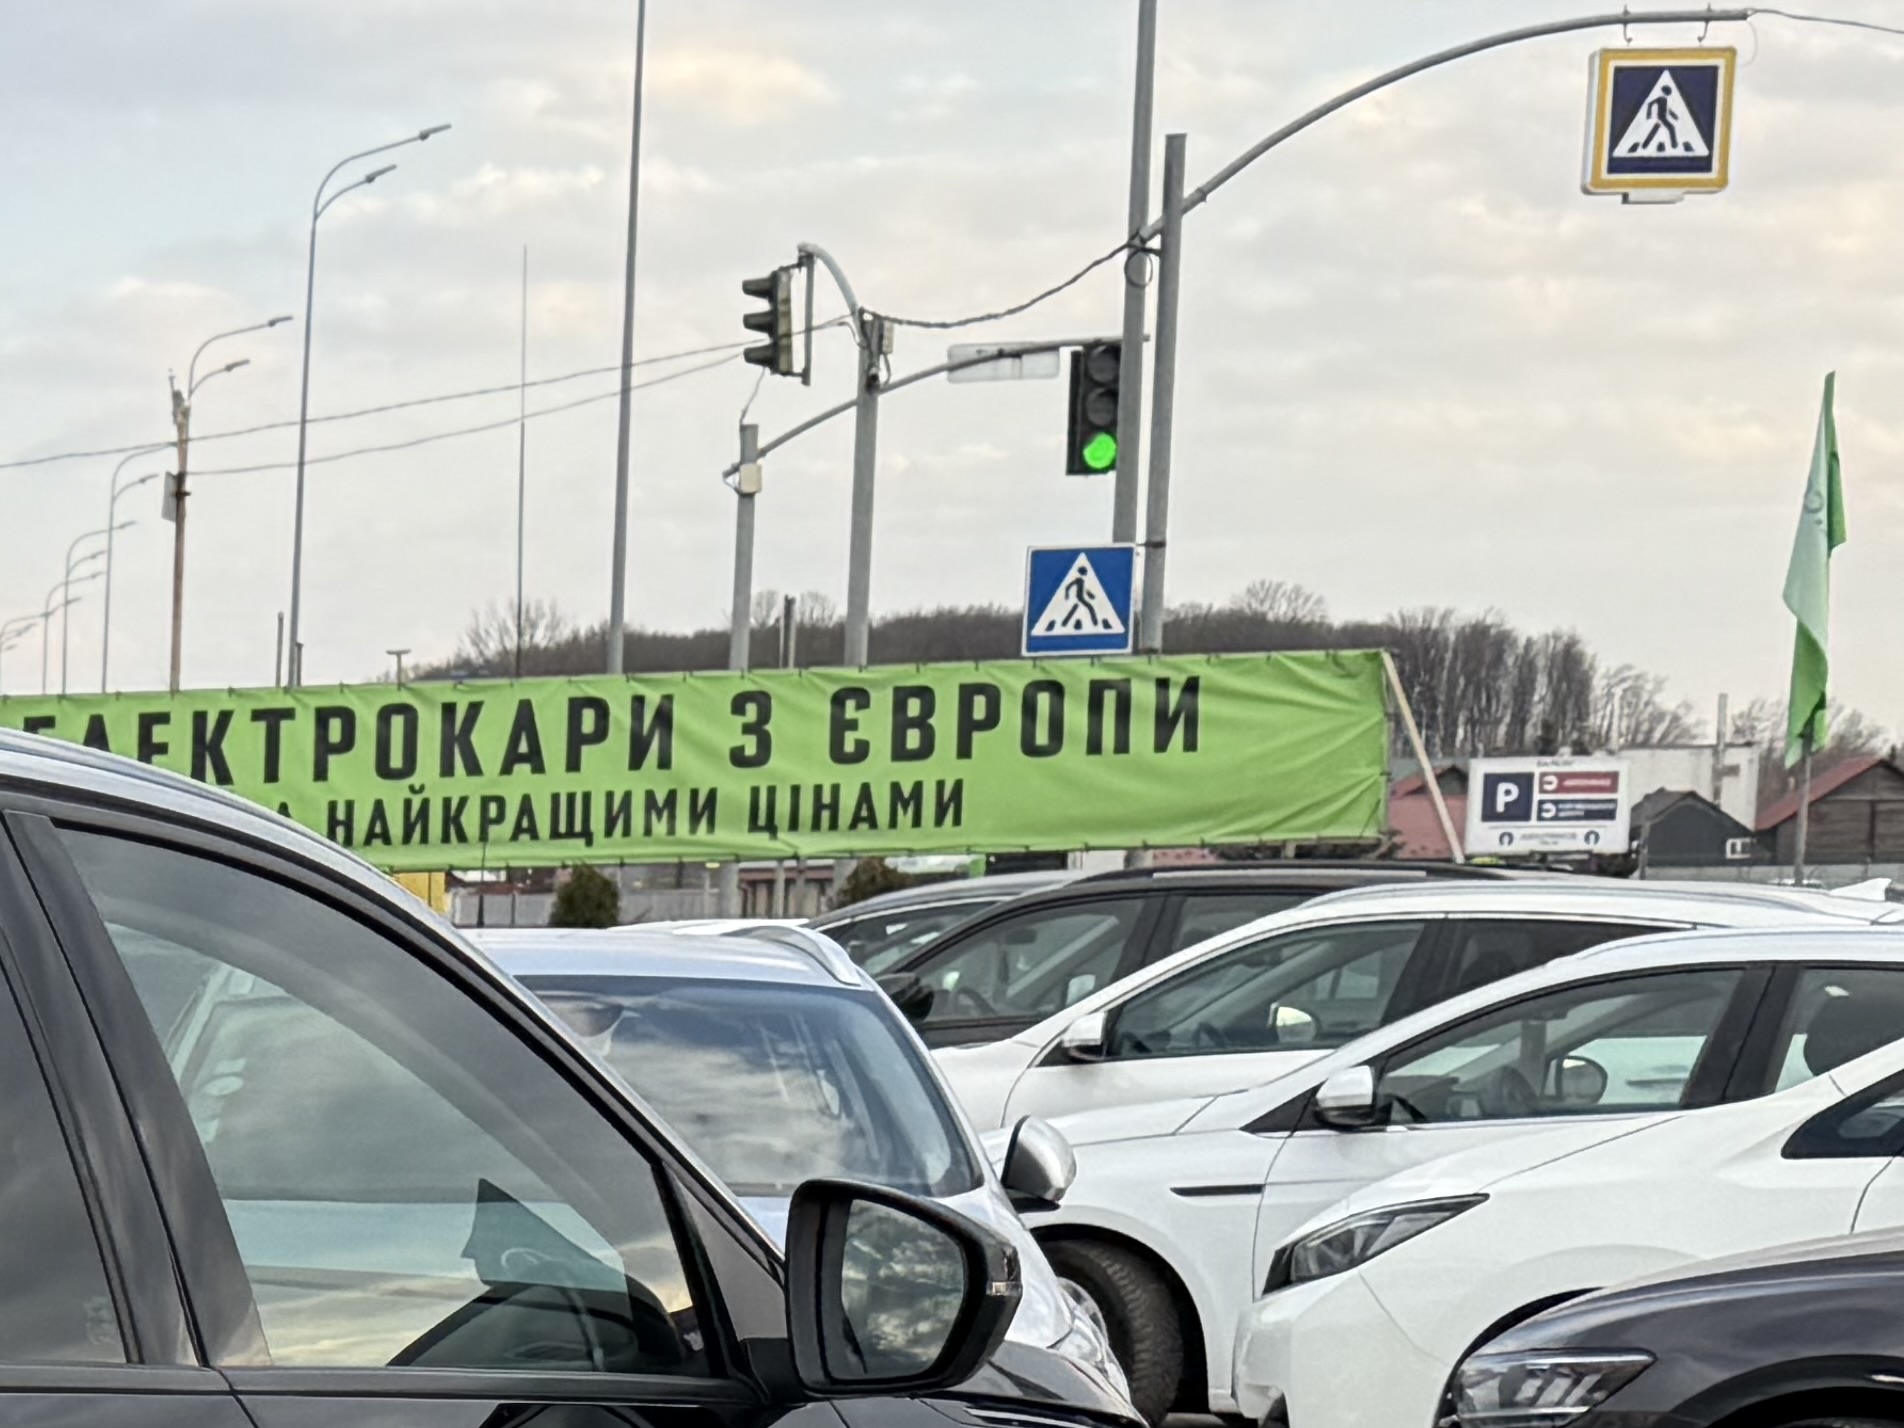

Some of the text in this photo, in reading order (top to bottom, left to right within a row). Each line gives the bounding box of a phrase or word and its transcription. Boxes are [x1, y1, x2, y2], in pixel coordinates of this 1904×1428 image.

[23, 676, 1200, 786] ЕКТРОКАРИ З ЄВРОПИ
[327, 778, 964, 848] НАЙКРАЩИМИ ЦІНАМИ
[1495, 782, 1520, 813] P
